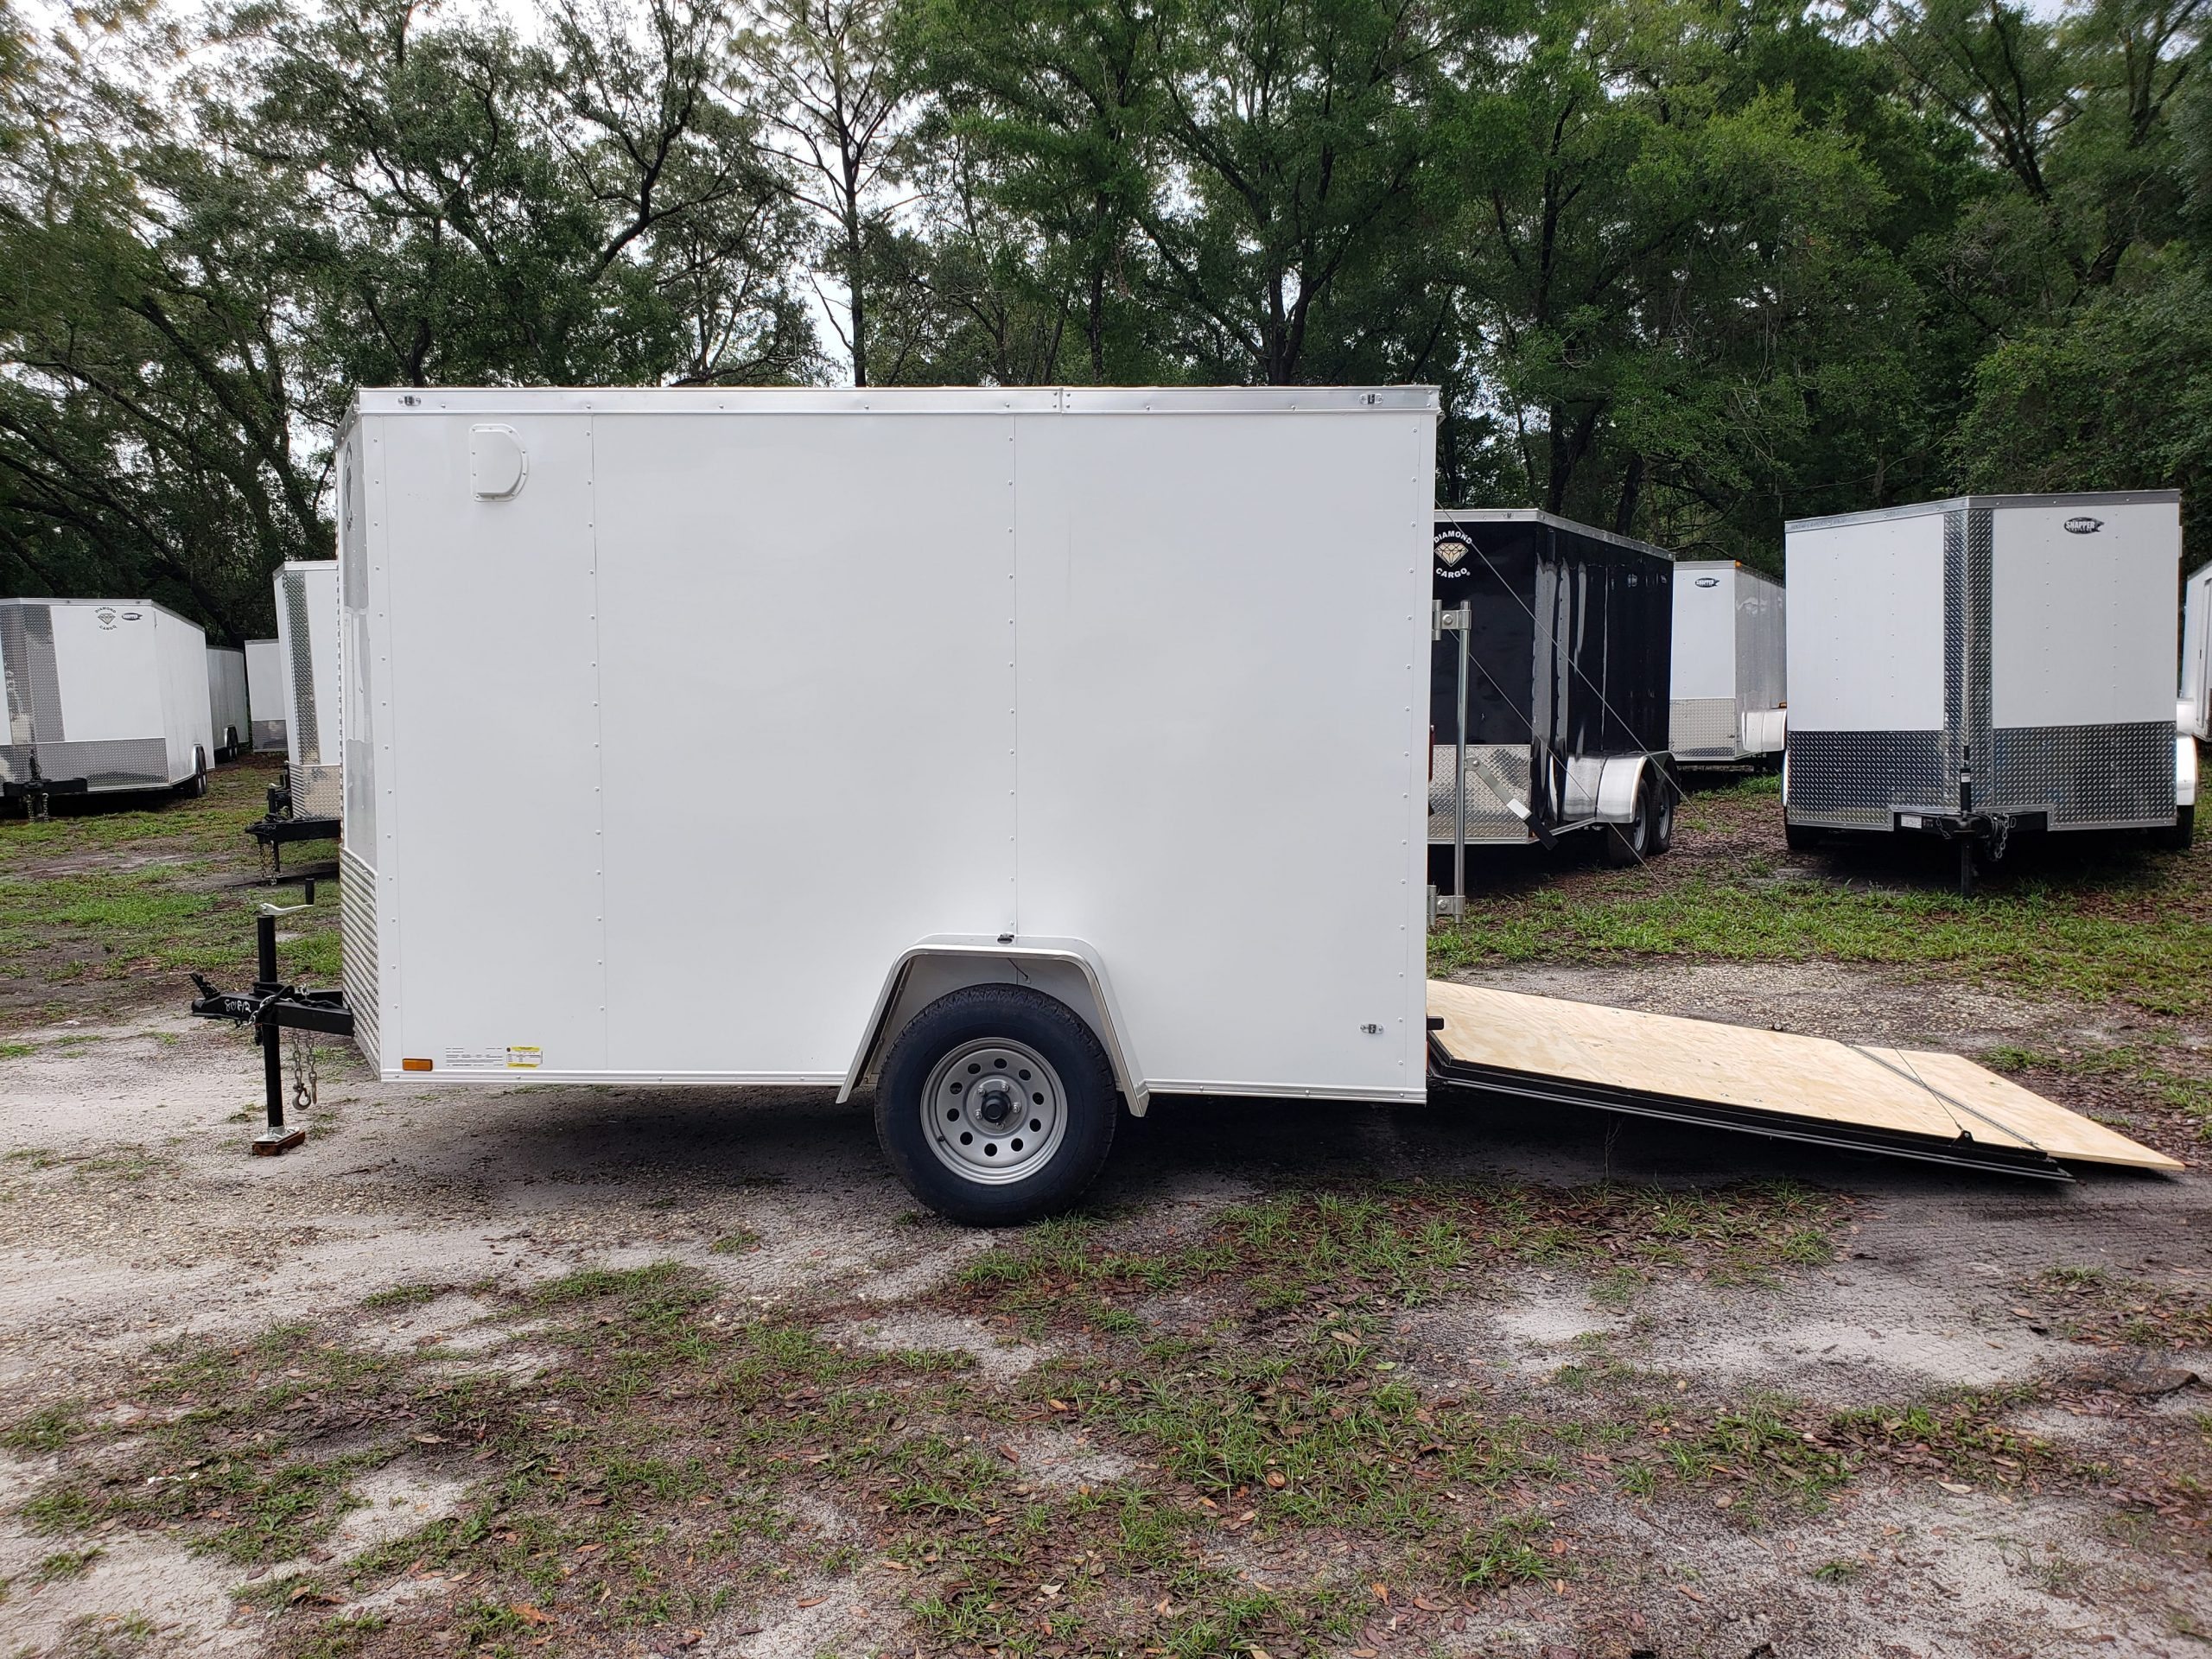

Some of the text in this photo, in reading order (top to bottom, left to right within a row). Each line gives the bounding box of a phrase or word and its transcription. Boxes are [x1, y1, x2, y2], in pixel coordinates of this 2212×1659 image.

[2065, 521, 2095, 530] SNAPPER
[1433, 531, 1472, 544] DIAMOND
[1435, 568, 1468, 578] CARGO
